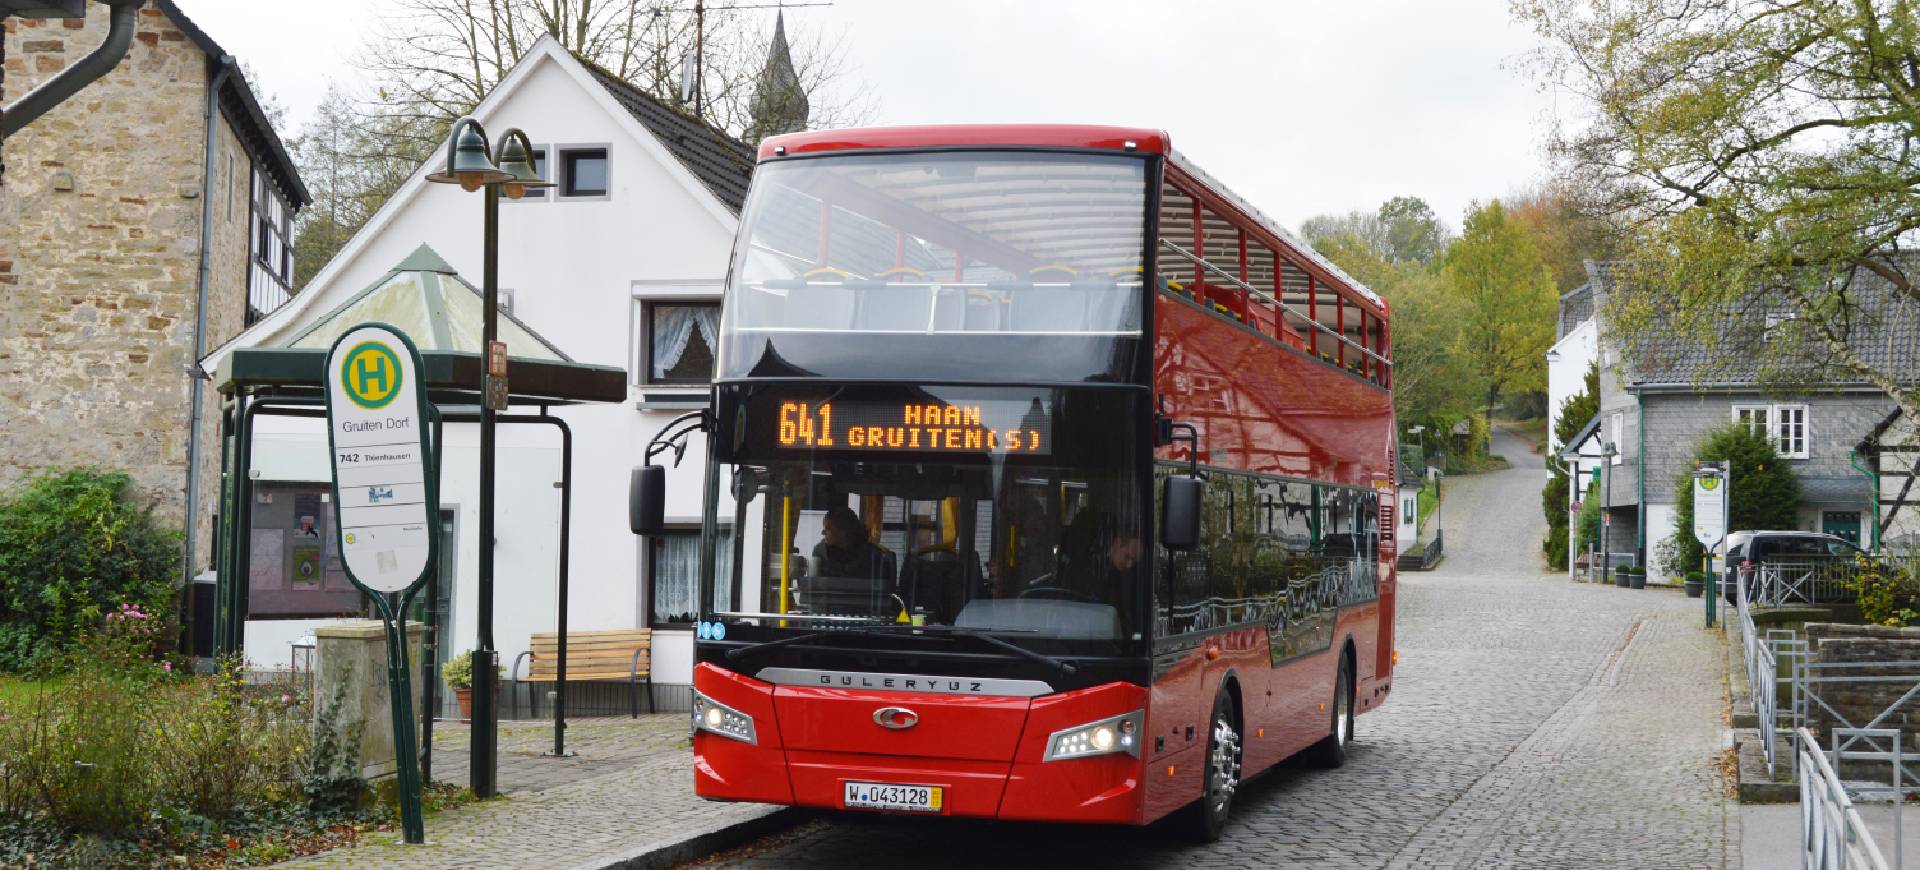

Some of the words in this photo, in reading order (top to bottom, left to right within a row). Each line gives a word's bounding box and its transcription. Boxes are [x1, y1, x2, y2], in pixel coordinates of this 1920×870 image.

[357, 357, 387, 394] H
[342, 420, 382, 433] Gruiten
[386, 416, 410, 429] Dorf
[779, 403, 832, 446] 641
[904, 405, 980, 425] HAAN
[849, 427, 1039, 449] GRUITEN(S)
[339, 453, 360, 463] 742
[870, 786, 928, 806] 043128
